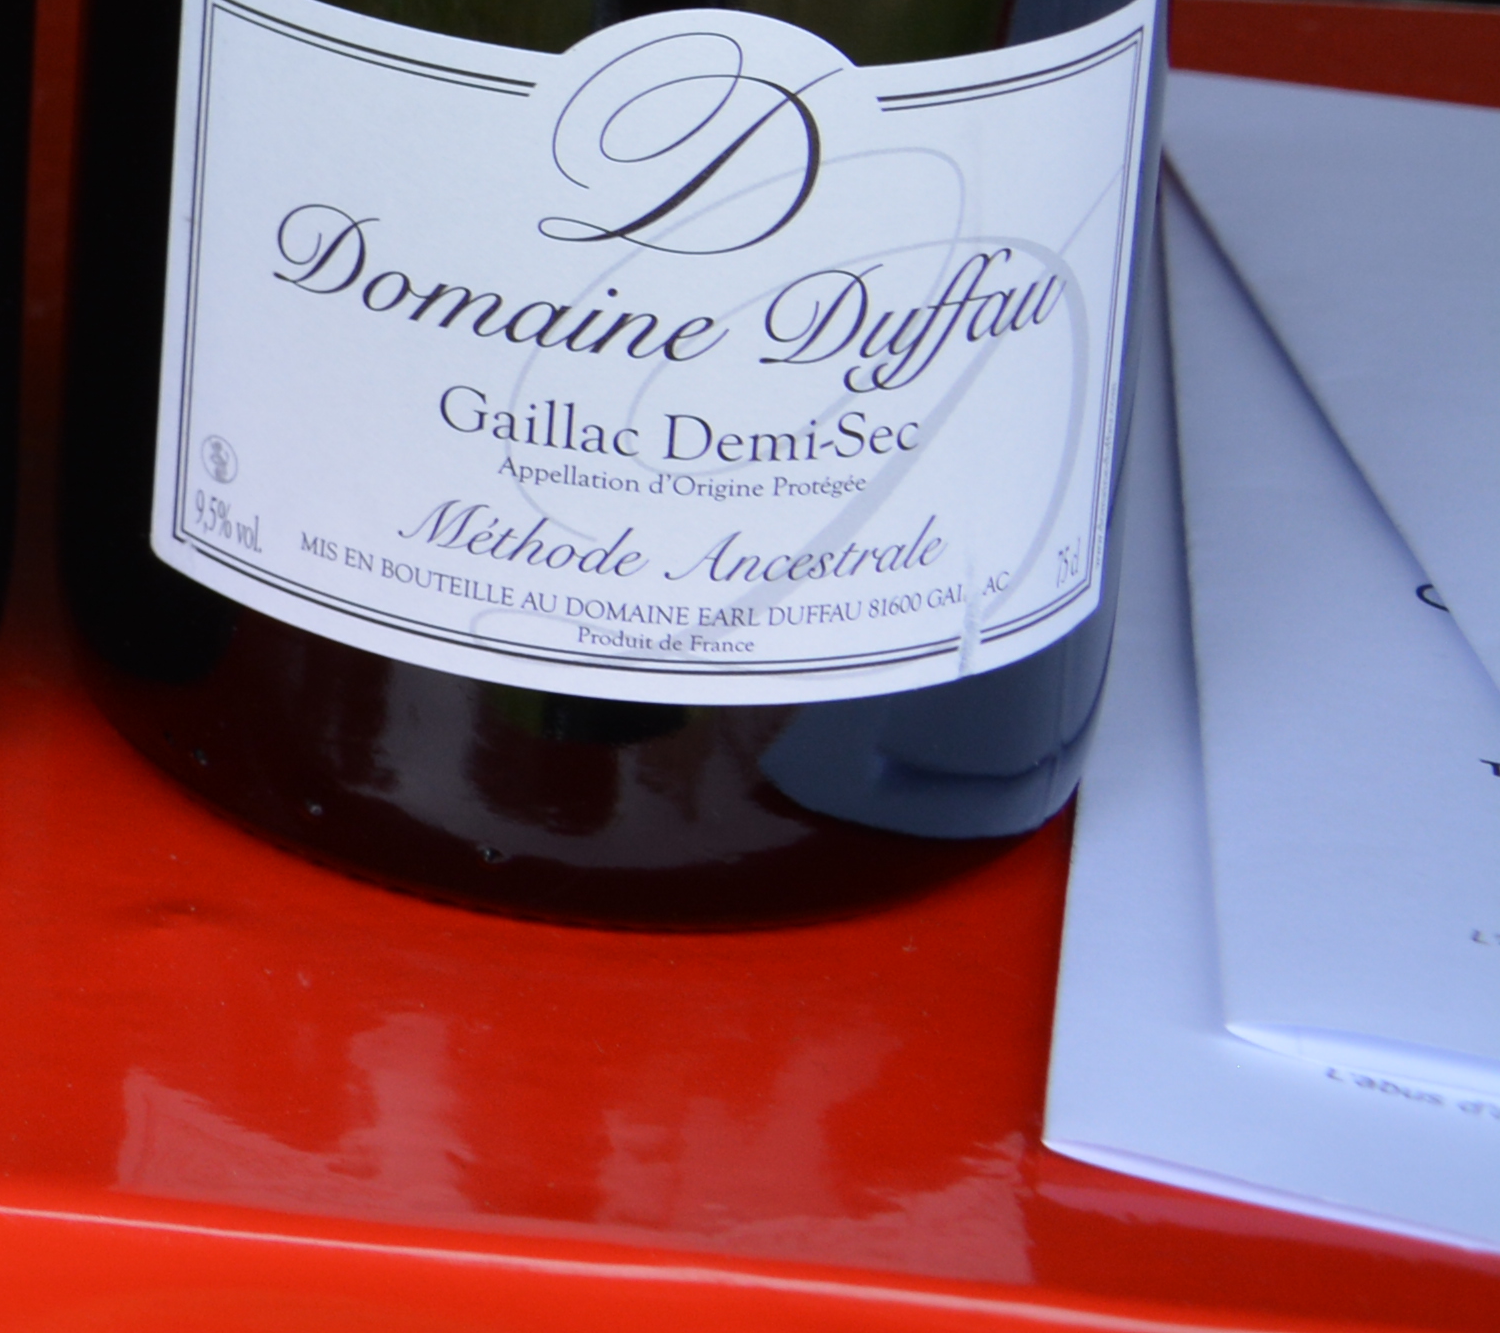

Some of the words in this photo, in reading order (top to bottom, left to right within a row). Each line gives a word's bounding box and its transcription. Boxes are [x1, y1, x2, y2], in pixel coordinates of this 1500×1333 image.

[272, 203, 730, 363] Domaine
[759, 246, 1065, 394] Duffau
[439, 385, 640, 458] Gaillac
[662, 411, 920, 463] Demi-Sec
[498, 455, 640, 494] Appellation
[773, 473, 868, 500] Protégée
[300, 531, 339, 562] MIS
[345, 547, 375, 573] EN
[381, 559, 516, 608] BOUTEILLE
[521, 590, 558, 614] AU
[566, 596, 690, 627] DOMAINE
[698, 606, 761, 628] EARL
[768, 601, 863, 627] DUFFAU
[867, 592, 922, 620] 81600
[397, 499, 649, 578] Méthode
[665, 514, 949, 583] Ancestrale
[577, 626, 653, 651] Produit
[658, 635, 683, 652] de
[689, 635, 756, 655] France
